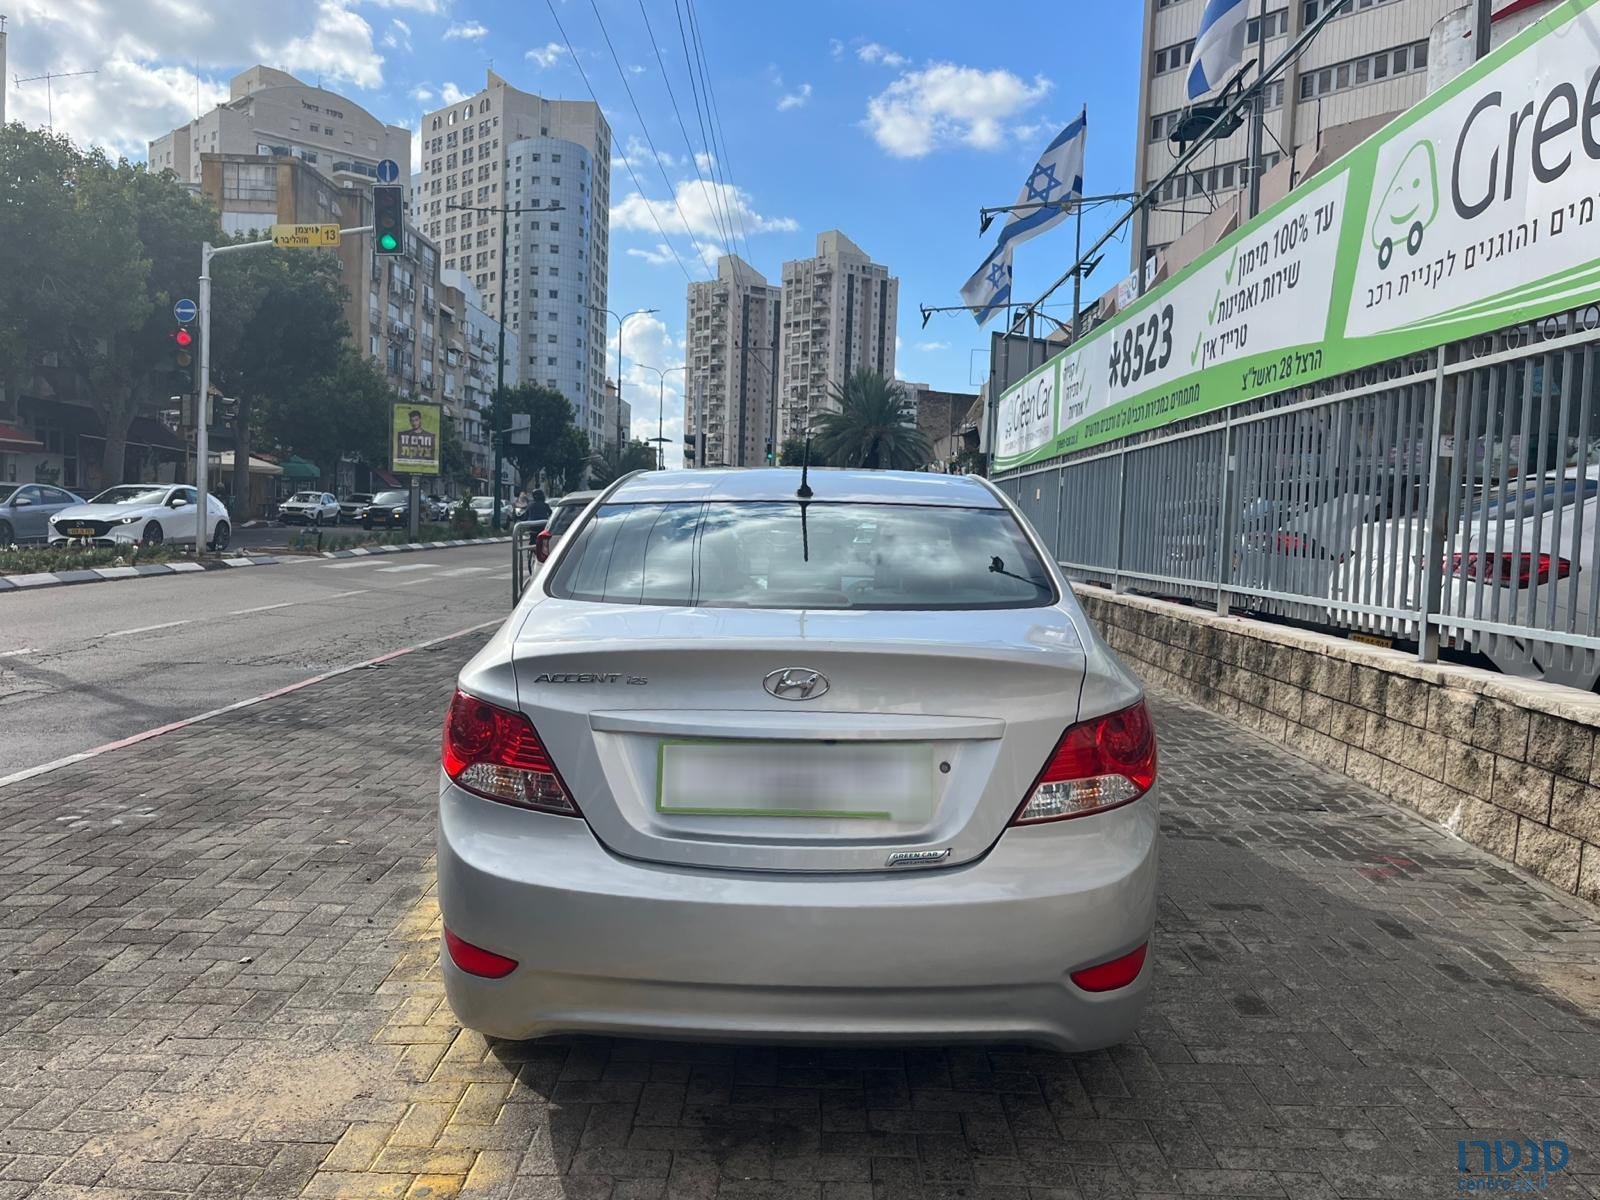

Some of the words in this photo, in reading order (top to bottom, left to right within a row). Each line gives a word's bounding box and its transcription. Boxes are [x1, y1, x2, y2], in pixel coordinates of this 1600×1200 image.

[1314, 201, 1334, 235] עד
[1550, 191, 1600, 236] מים
[324, 230, 336, 240] 13
[1273, 214, 1308, 258] 100%
[1464, 218, 1538, 270] והוגנים
[1238, 241, 1269, 286] מימון
[1398, 250, 1456, 296] לקניית
[1260, 260, 1300, 302] שירות
[1366, 280, 1392, 308] רכב
[1218, 282, 1259, 324] ואמינות
[1202, 338, 1218, 370] אין
[1220, 324, 1248, 355] טרייד
[1280, 354, 1292, 380] 28
[1296, 349, 1322, 375] הרצל
[1036, 378, 1052, 420] Car
[1170, 384, 1200, 409] מתמחים
[534, 672, 622, 684] ACCENT
[626, 675, 648, 686] i25
